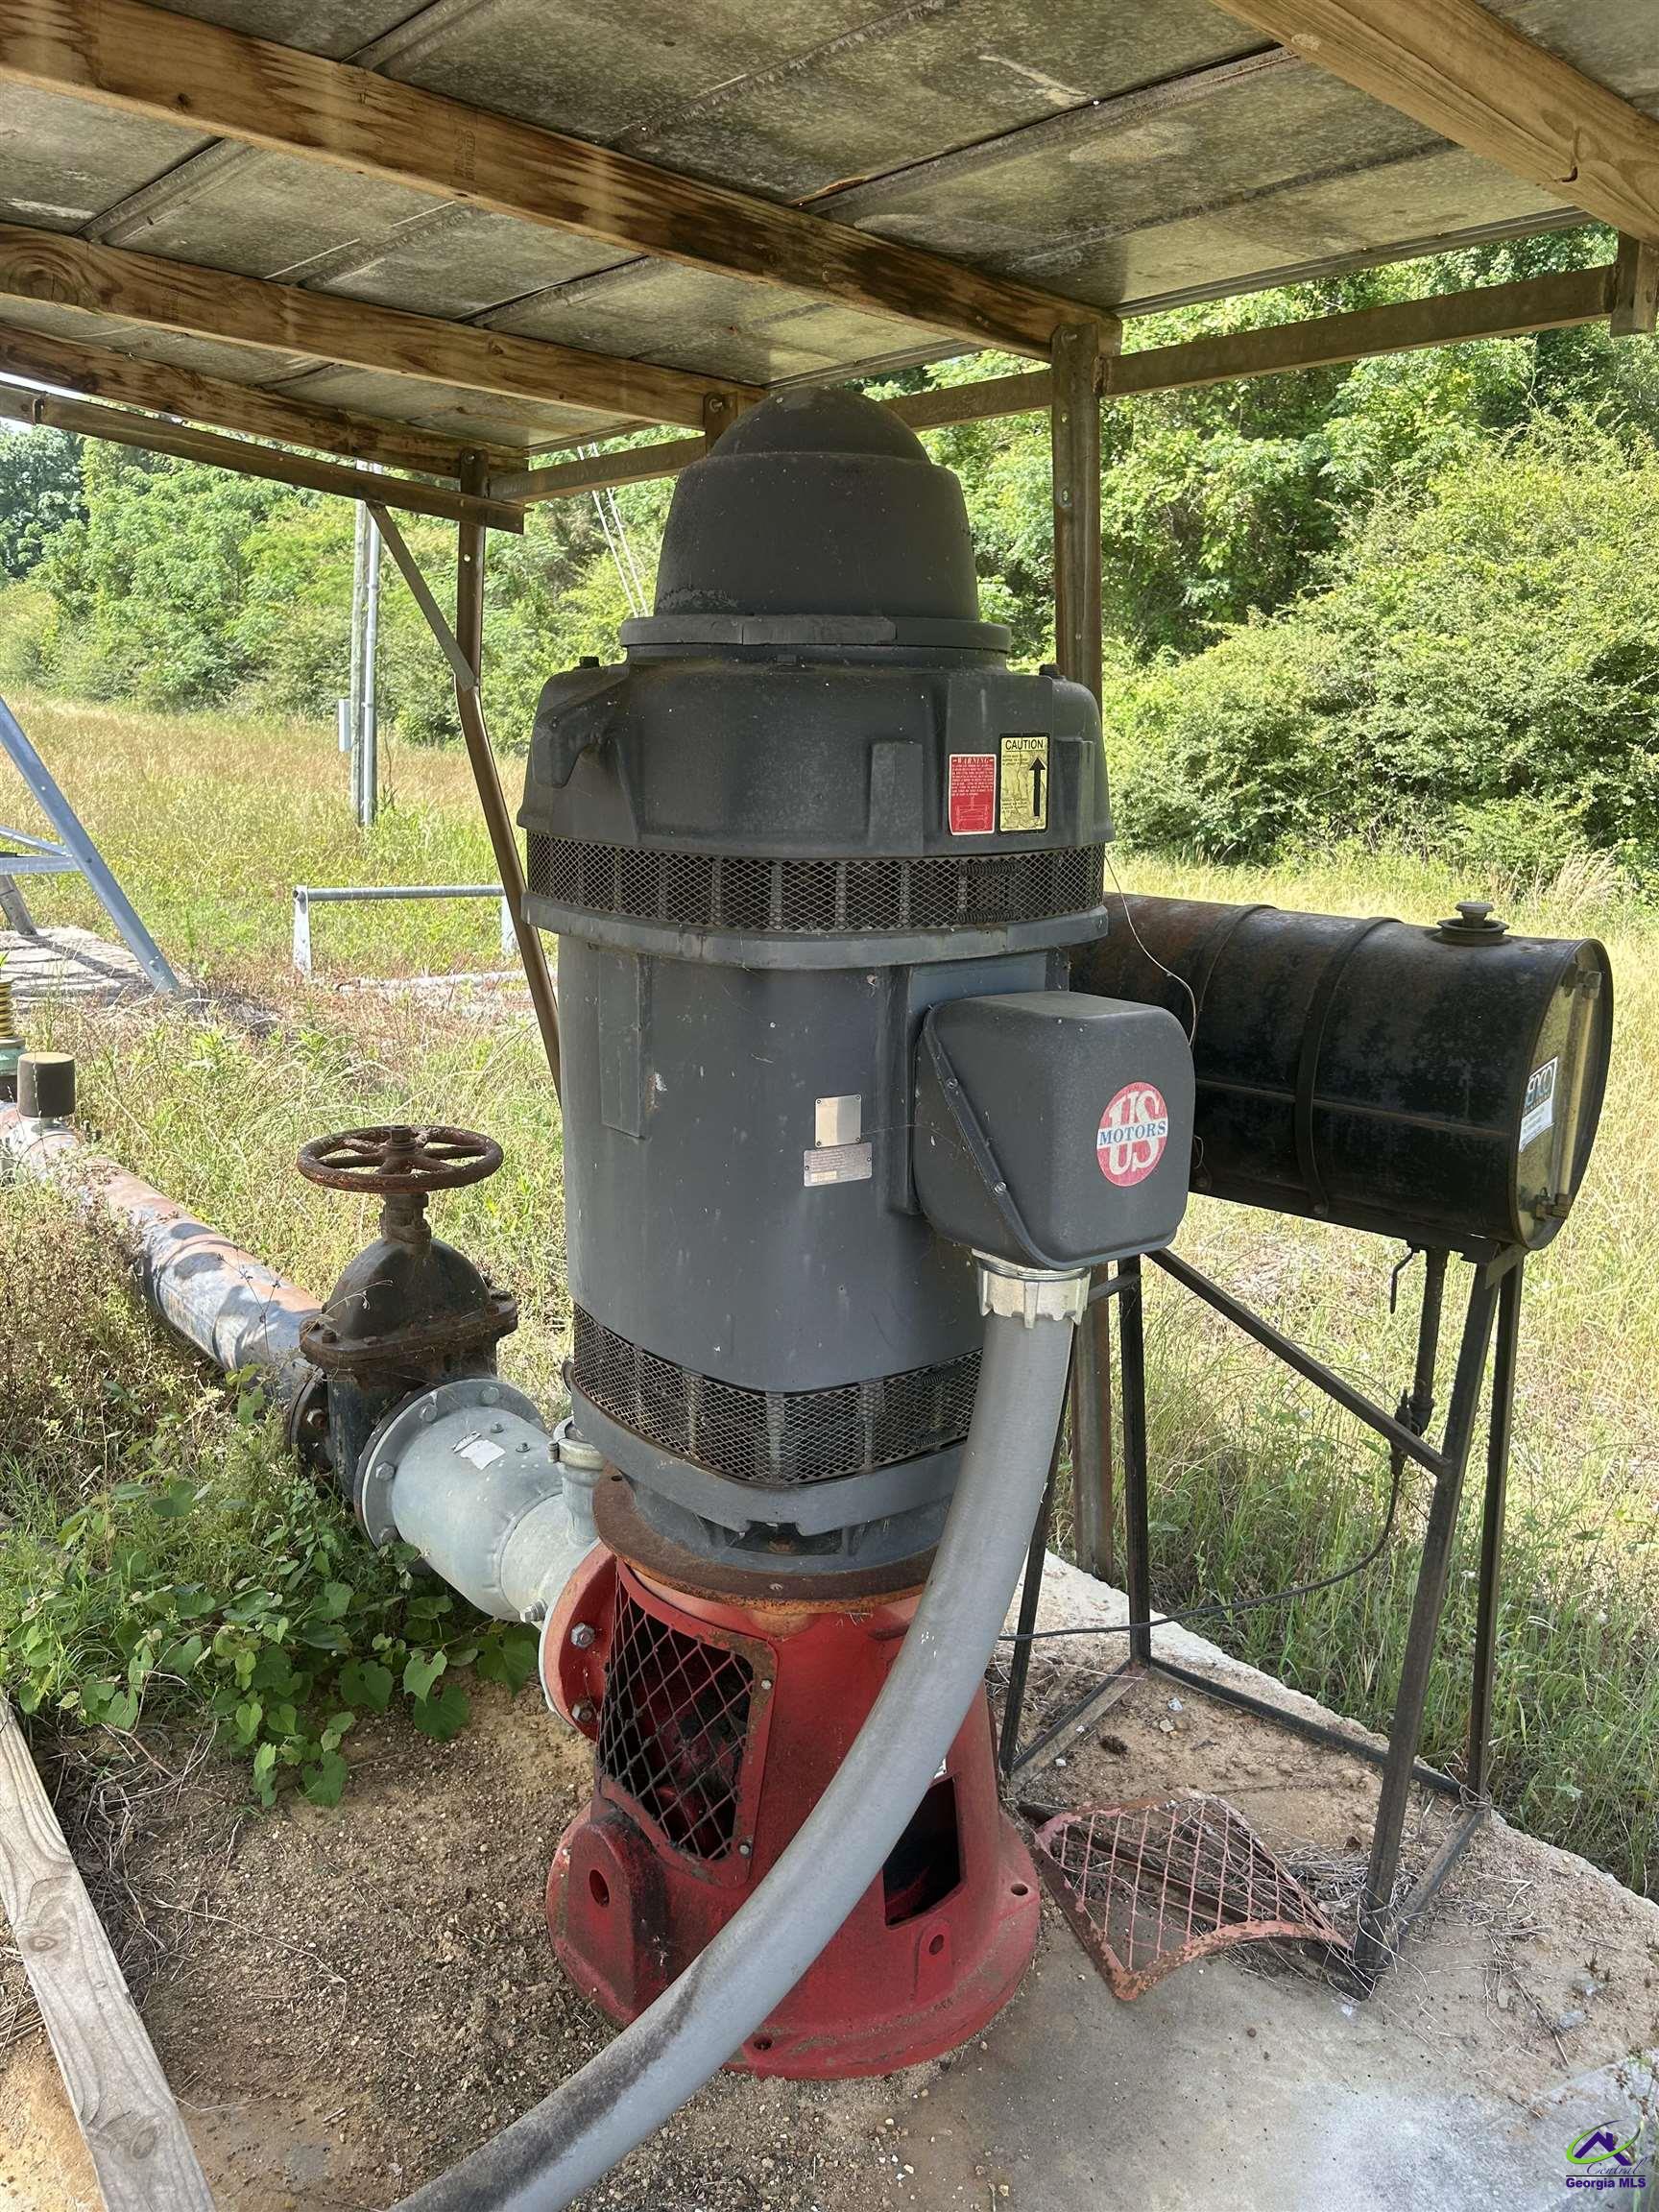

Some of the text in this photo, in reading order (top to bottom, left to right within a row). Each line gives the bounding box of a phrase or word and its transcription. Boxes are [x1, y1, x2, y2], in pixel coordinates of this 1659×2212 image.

[1005, 739, 1044, 750] CAUTION
[1099, 1120, 1166, 1145] MOTORS
[1109, 1090, 1160, 1175] US
